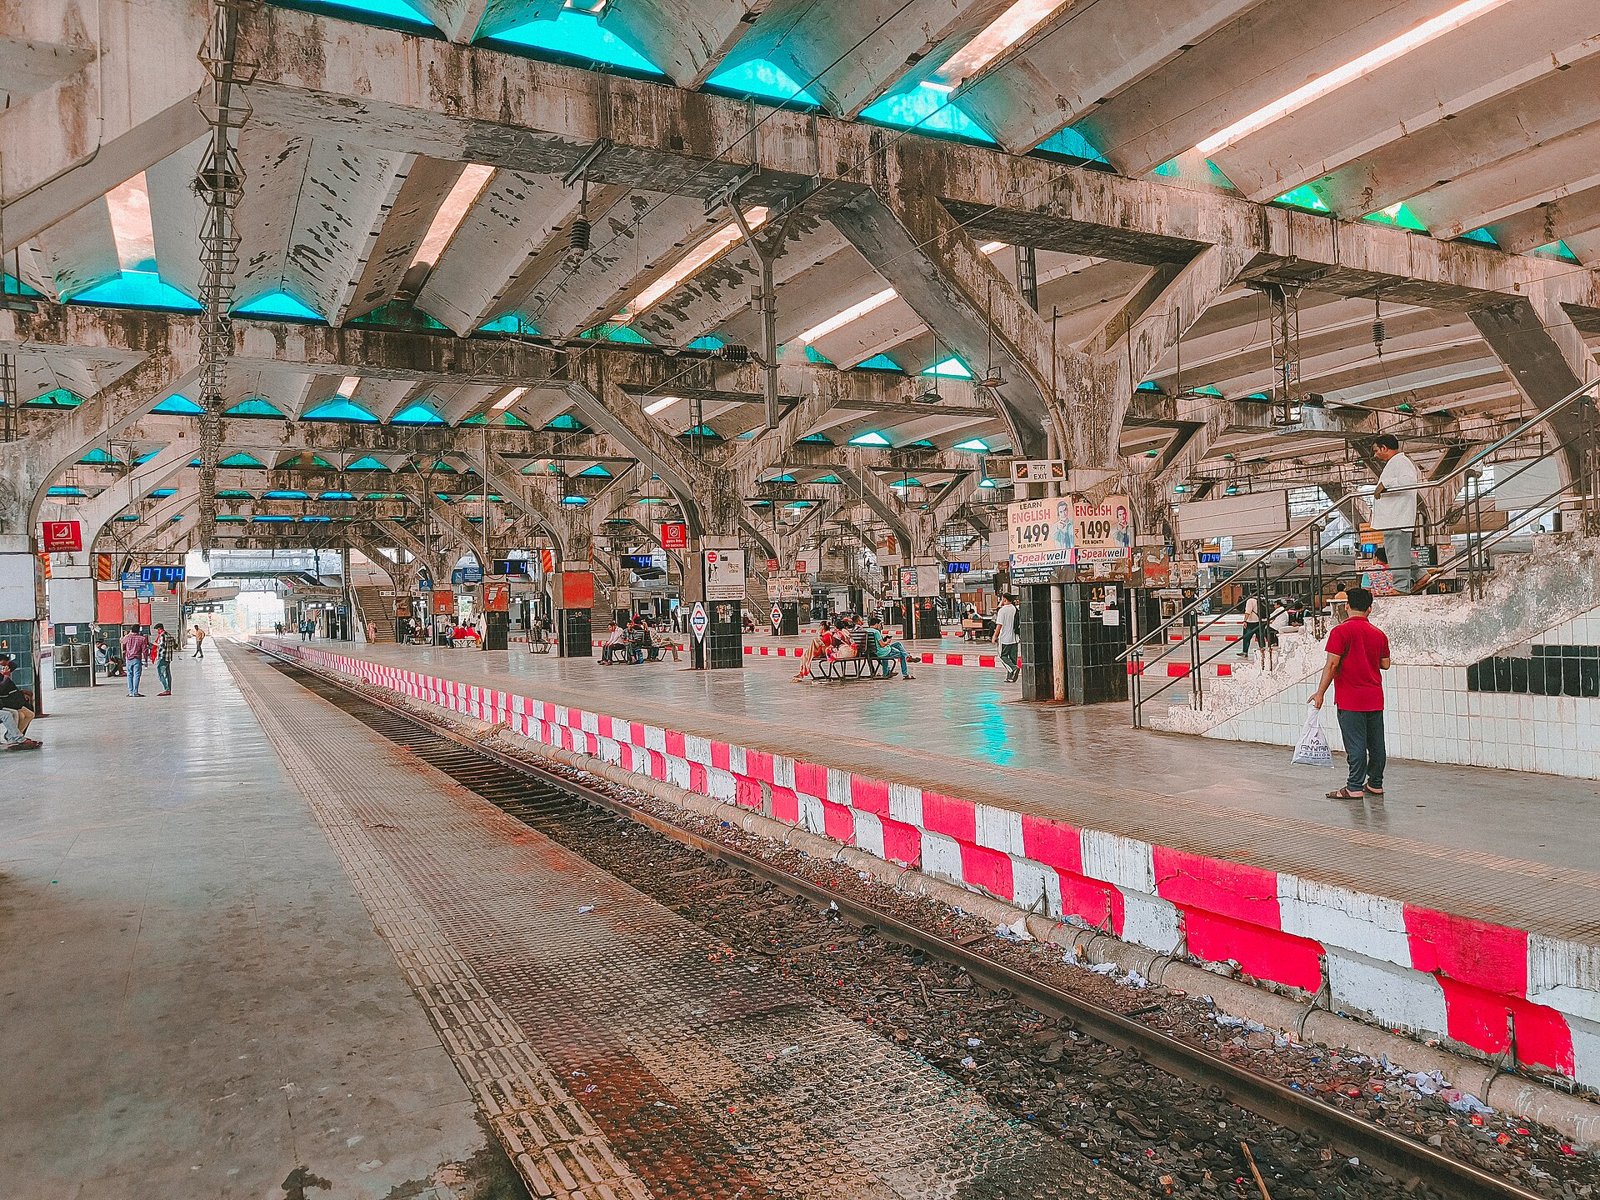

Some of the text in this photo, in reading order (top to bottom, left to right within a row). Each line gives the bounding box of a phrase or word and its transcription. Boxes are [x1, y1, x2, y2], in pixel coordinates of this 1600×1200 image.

[1020, 501, 1042, 510] LEARN
[1075, 504, 1112, 517] ENGLISH
[1012, 509, 1051, 524] ENGLISH
[1016, 522, 1050, 543] 1499
[1080, 520, 1110, 539] 1499
[1017, 550, 1067, 564] Speakwell
[1082, 548, 1125, 560] Speakwell
[142, 568, 184, 581] 0744
[948, 563, 970, 573] 0744
[1091, 587, 1105, 600] 12
